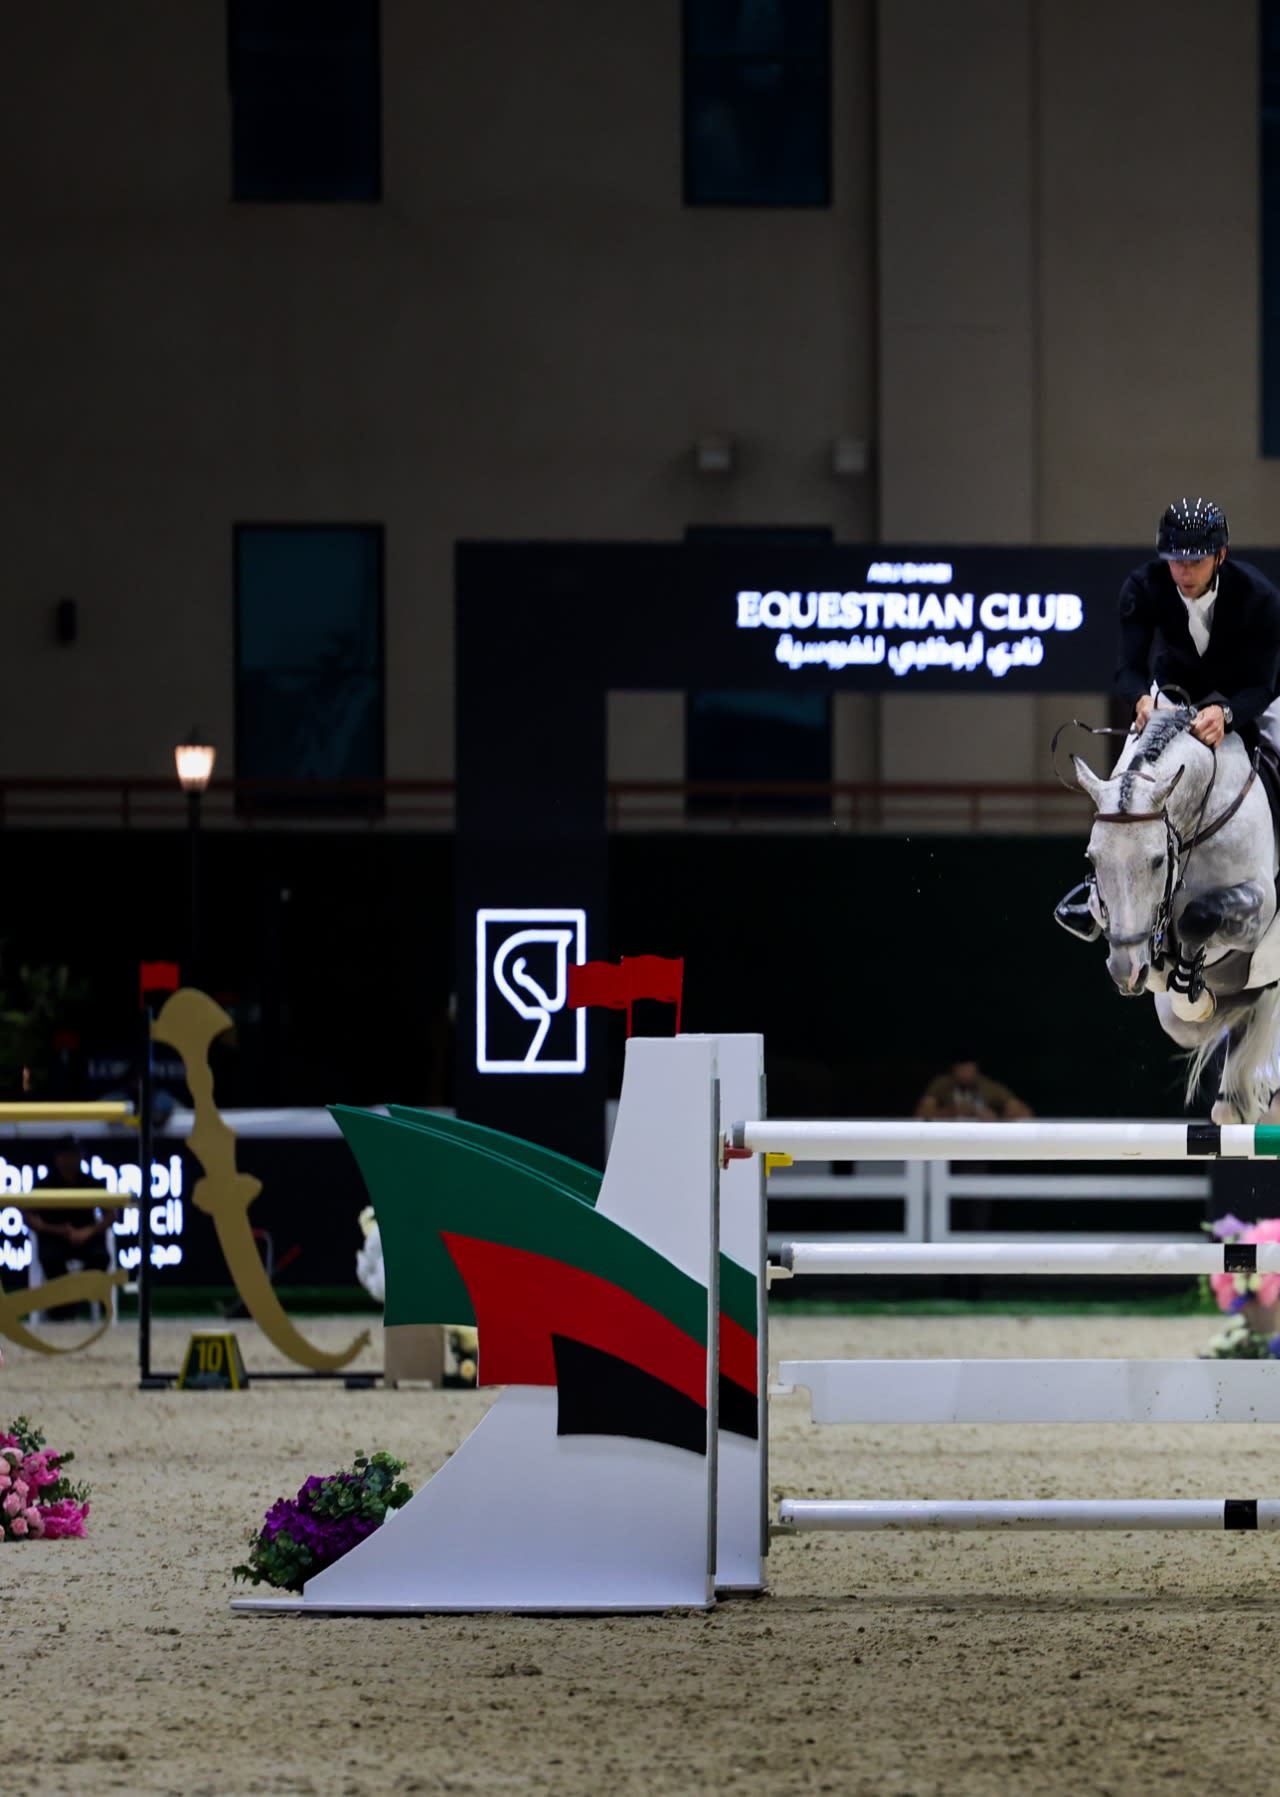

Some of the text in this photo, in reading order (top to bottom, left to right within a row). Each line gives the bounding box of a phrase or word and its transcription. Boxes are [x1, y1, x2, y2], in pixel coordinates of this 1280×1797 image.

[736, 591, 1083, 631] EQUESTRIAN CLUB
[197, 1341, 223, 1372] 10
